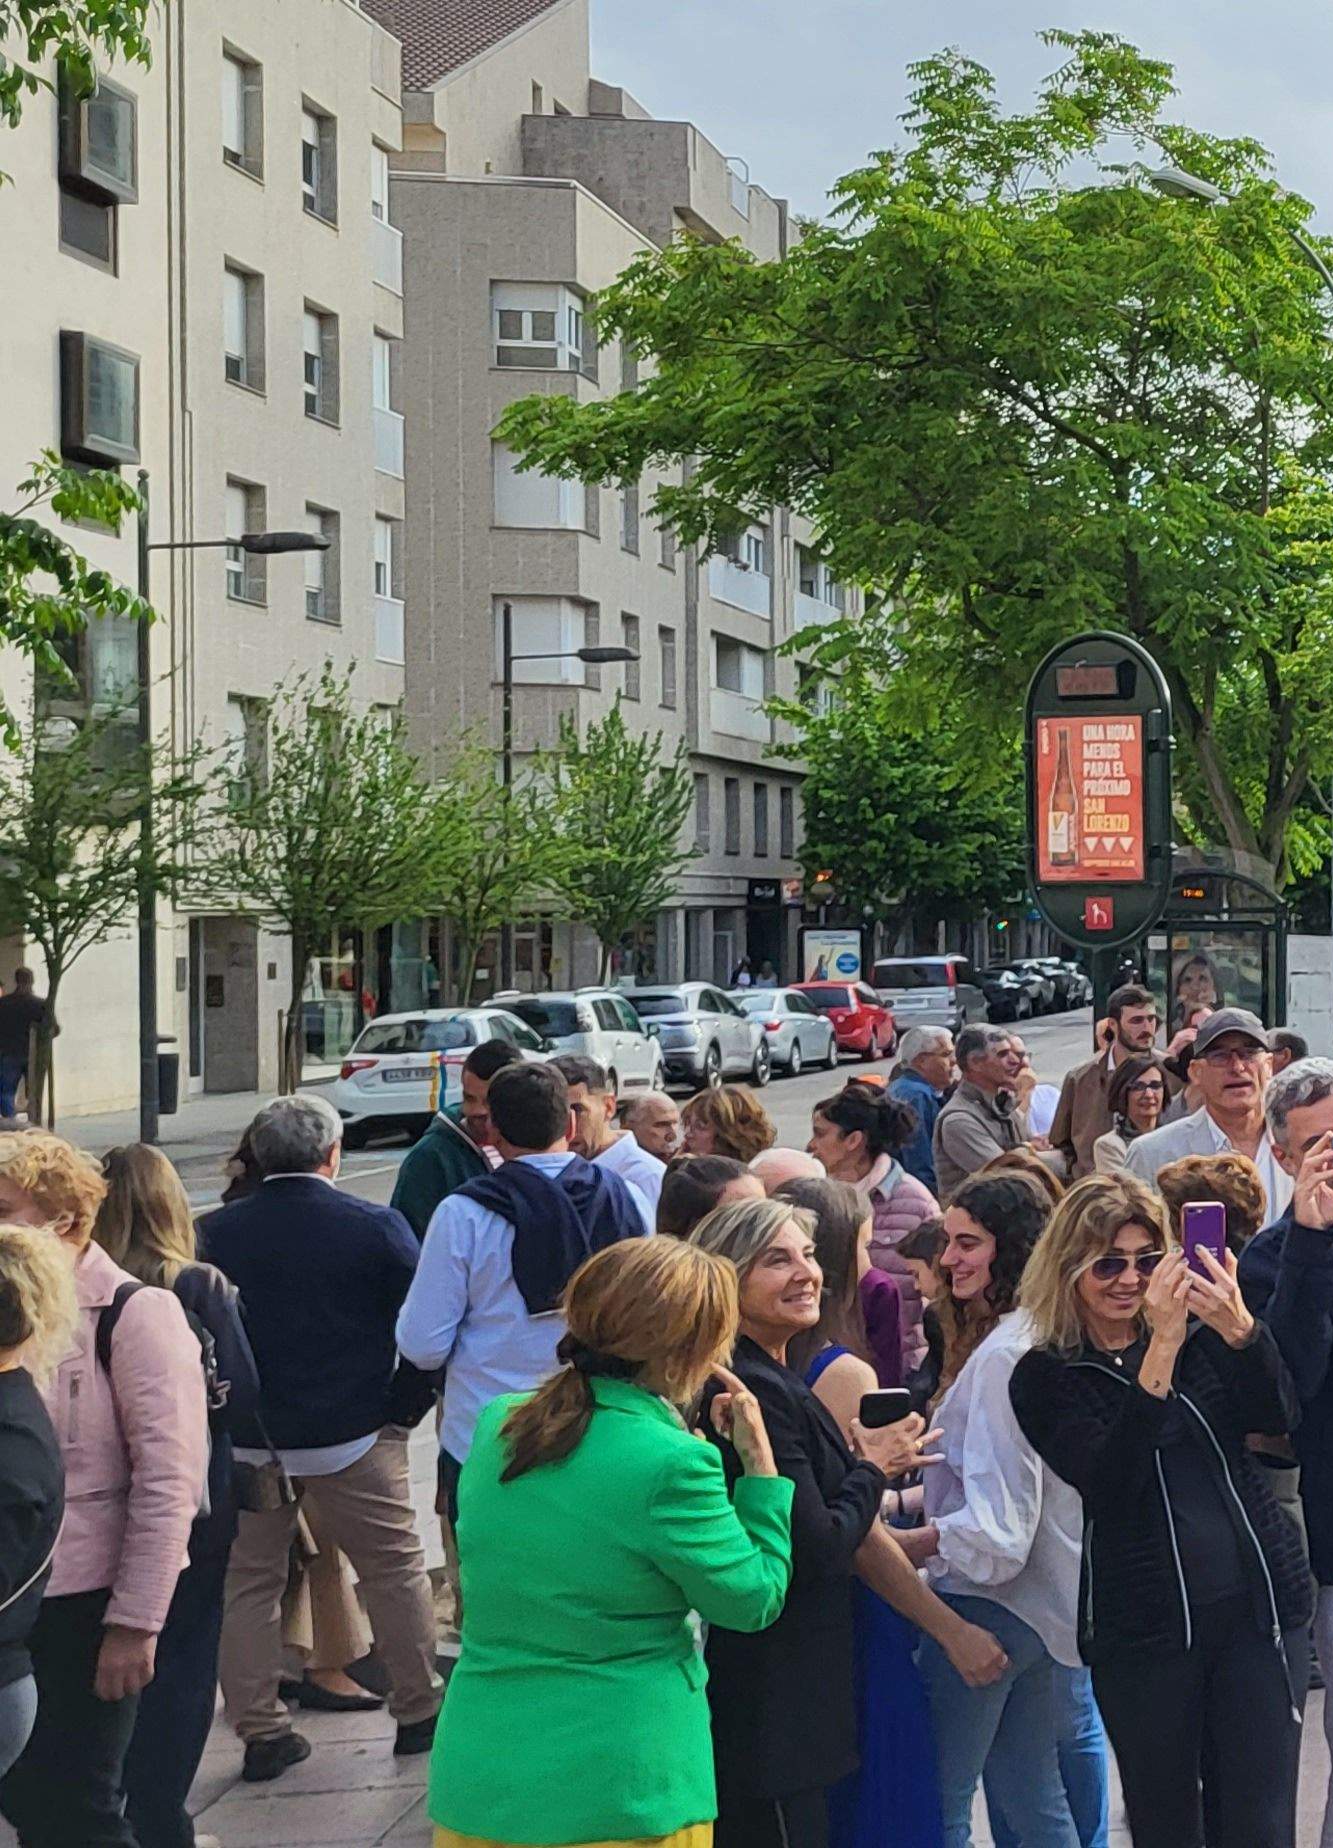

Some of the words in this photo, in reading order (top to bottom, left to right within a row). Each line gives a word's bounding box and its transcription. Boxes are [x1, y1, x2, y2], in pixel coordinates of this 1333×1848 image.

[1083, 724, 1105, 740] UNA
[1106, 724, 1135, 740] HORA
[1083, 742, 1121, 759] MENOS
[1083, 761, 1111, 778] PARA
[1113, 761, 1126, 778] EL
[1083, 777, 1131, 796] PRÓXIMO
[1083, 798, 1105, 814] SAN
[1083, 814, 1130, 832] LORENZO
